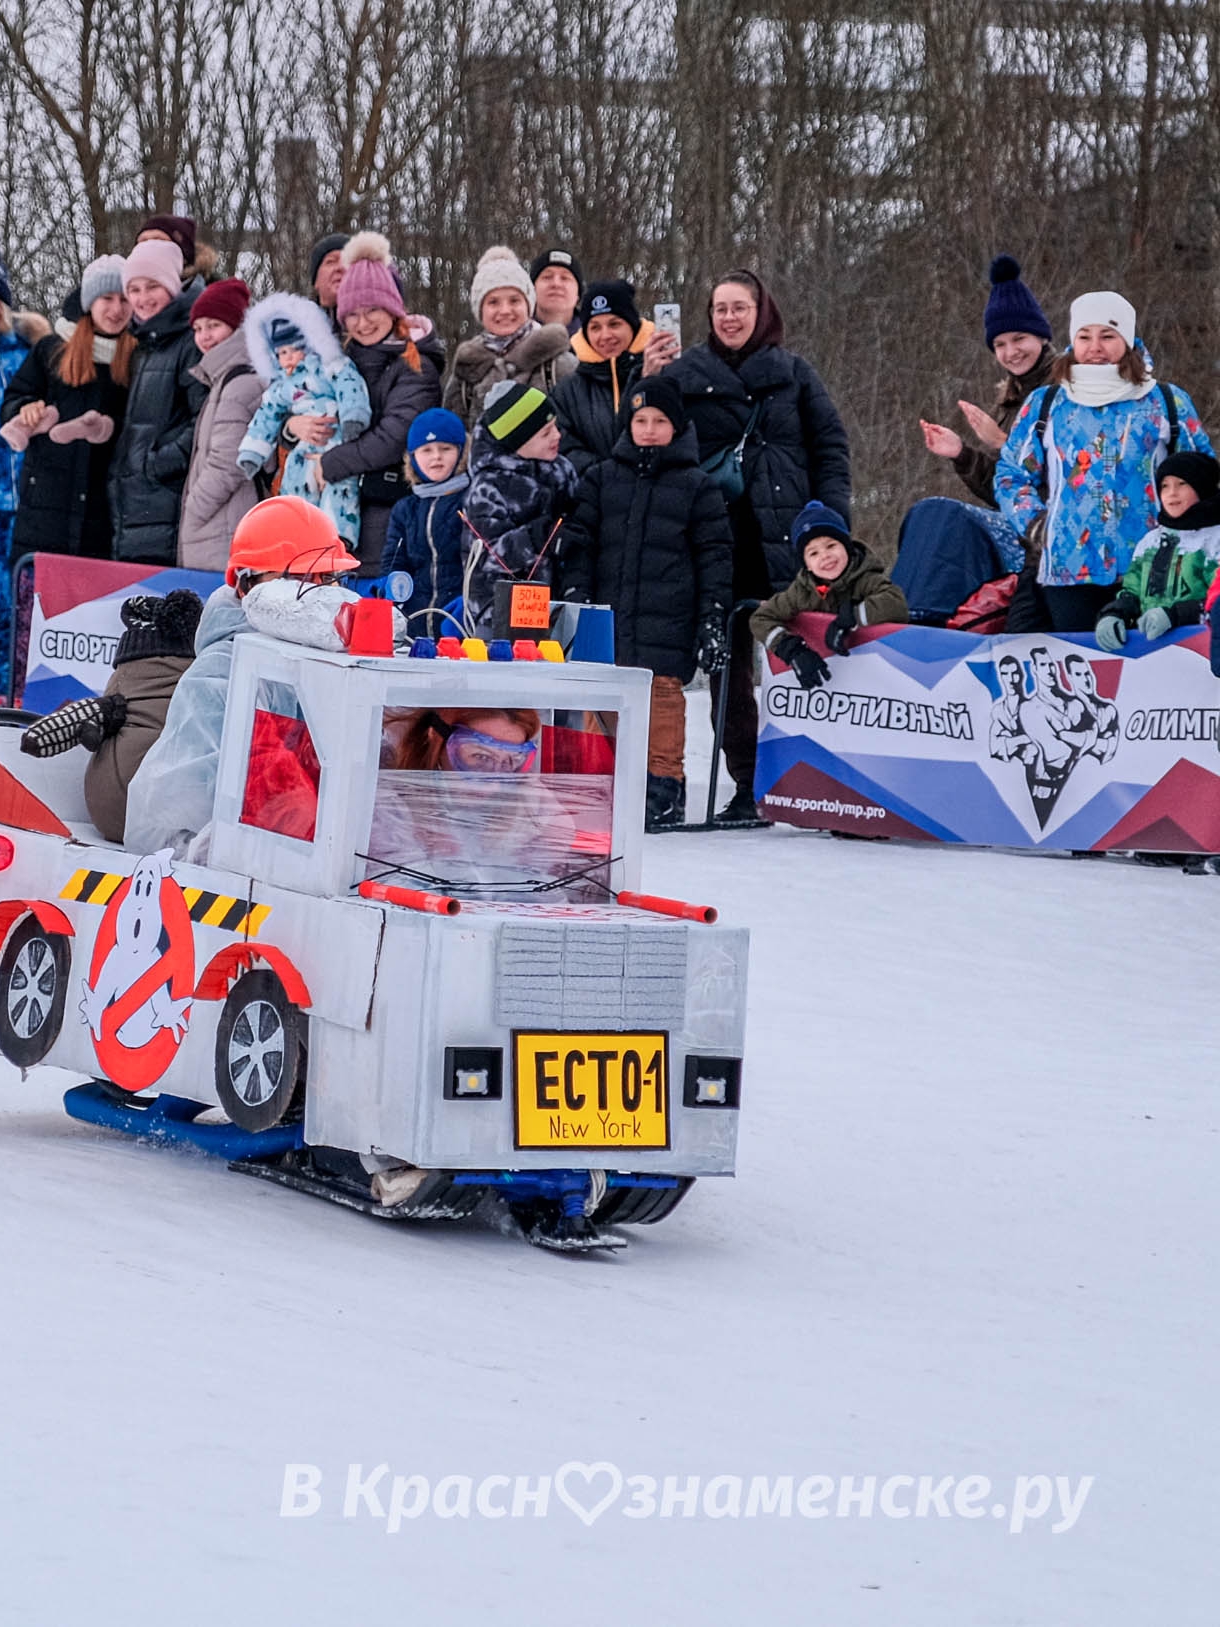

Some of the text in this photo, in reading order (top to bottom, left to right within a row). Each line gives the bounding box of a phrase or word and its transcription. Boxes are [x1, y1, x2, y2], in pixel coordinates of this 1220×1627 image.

[40, 629, 121, 665] СПОРТ
[767, 685, 974, 740] СПОРТИВНЫЙ
[764, 794, 886, 819] www.sportolymp.pro
[534, 1049, 663, 1114] ECTO-1
[596, 1112, 642, 1139] York
